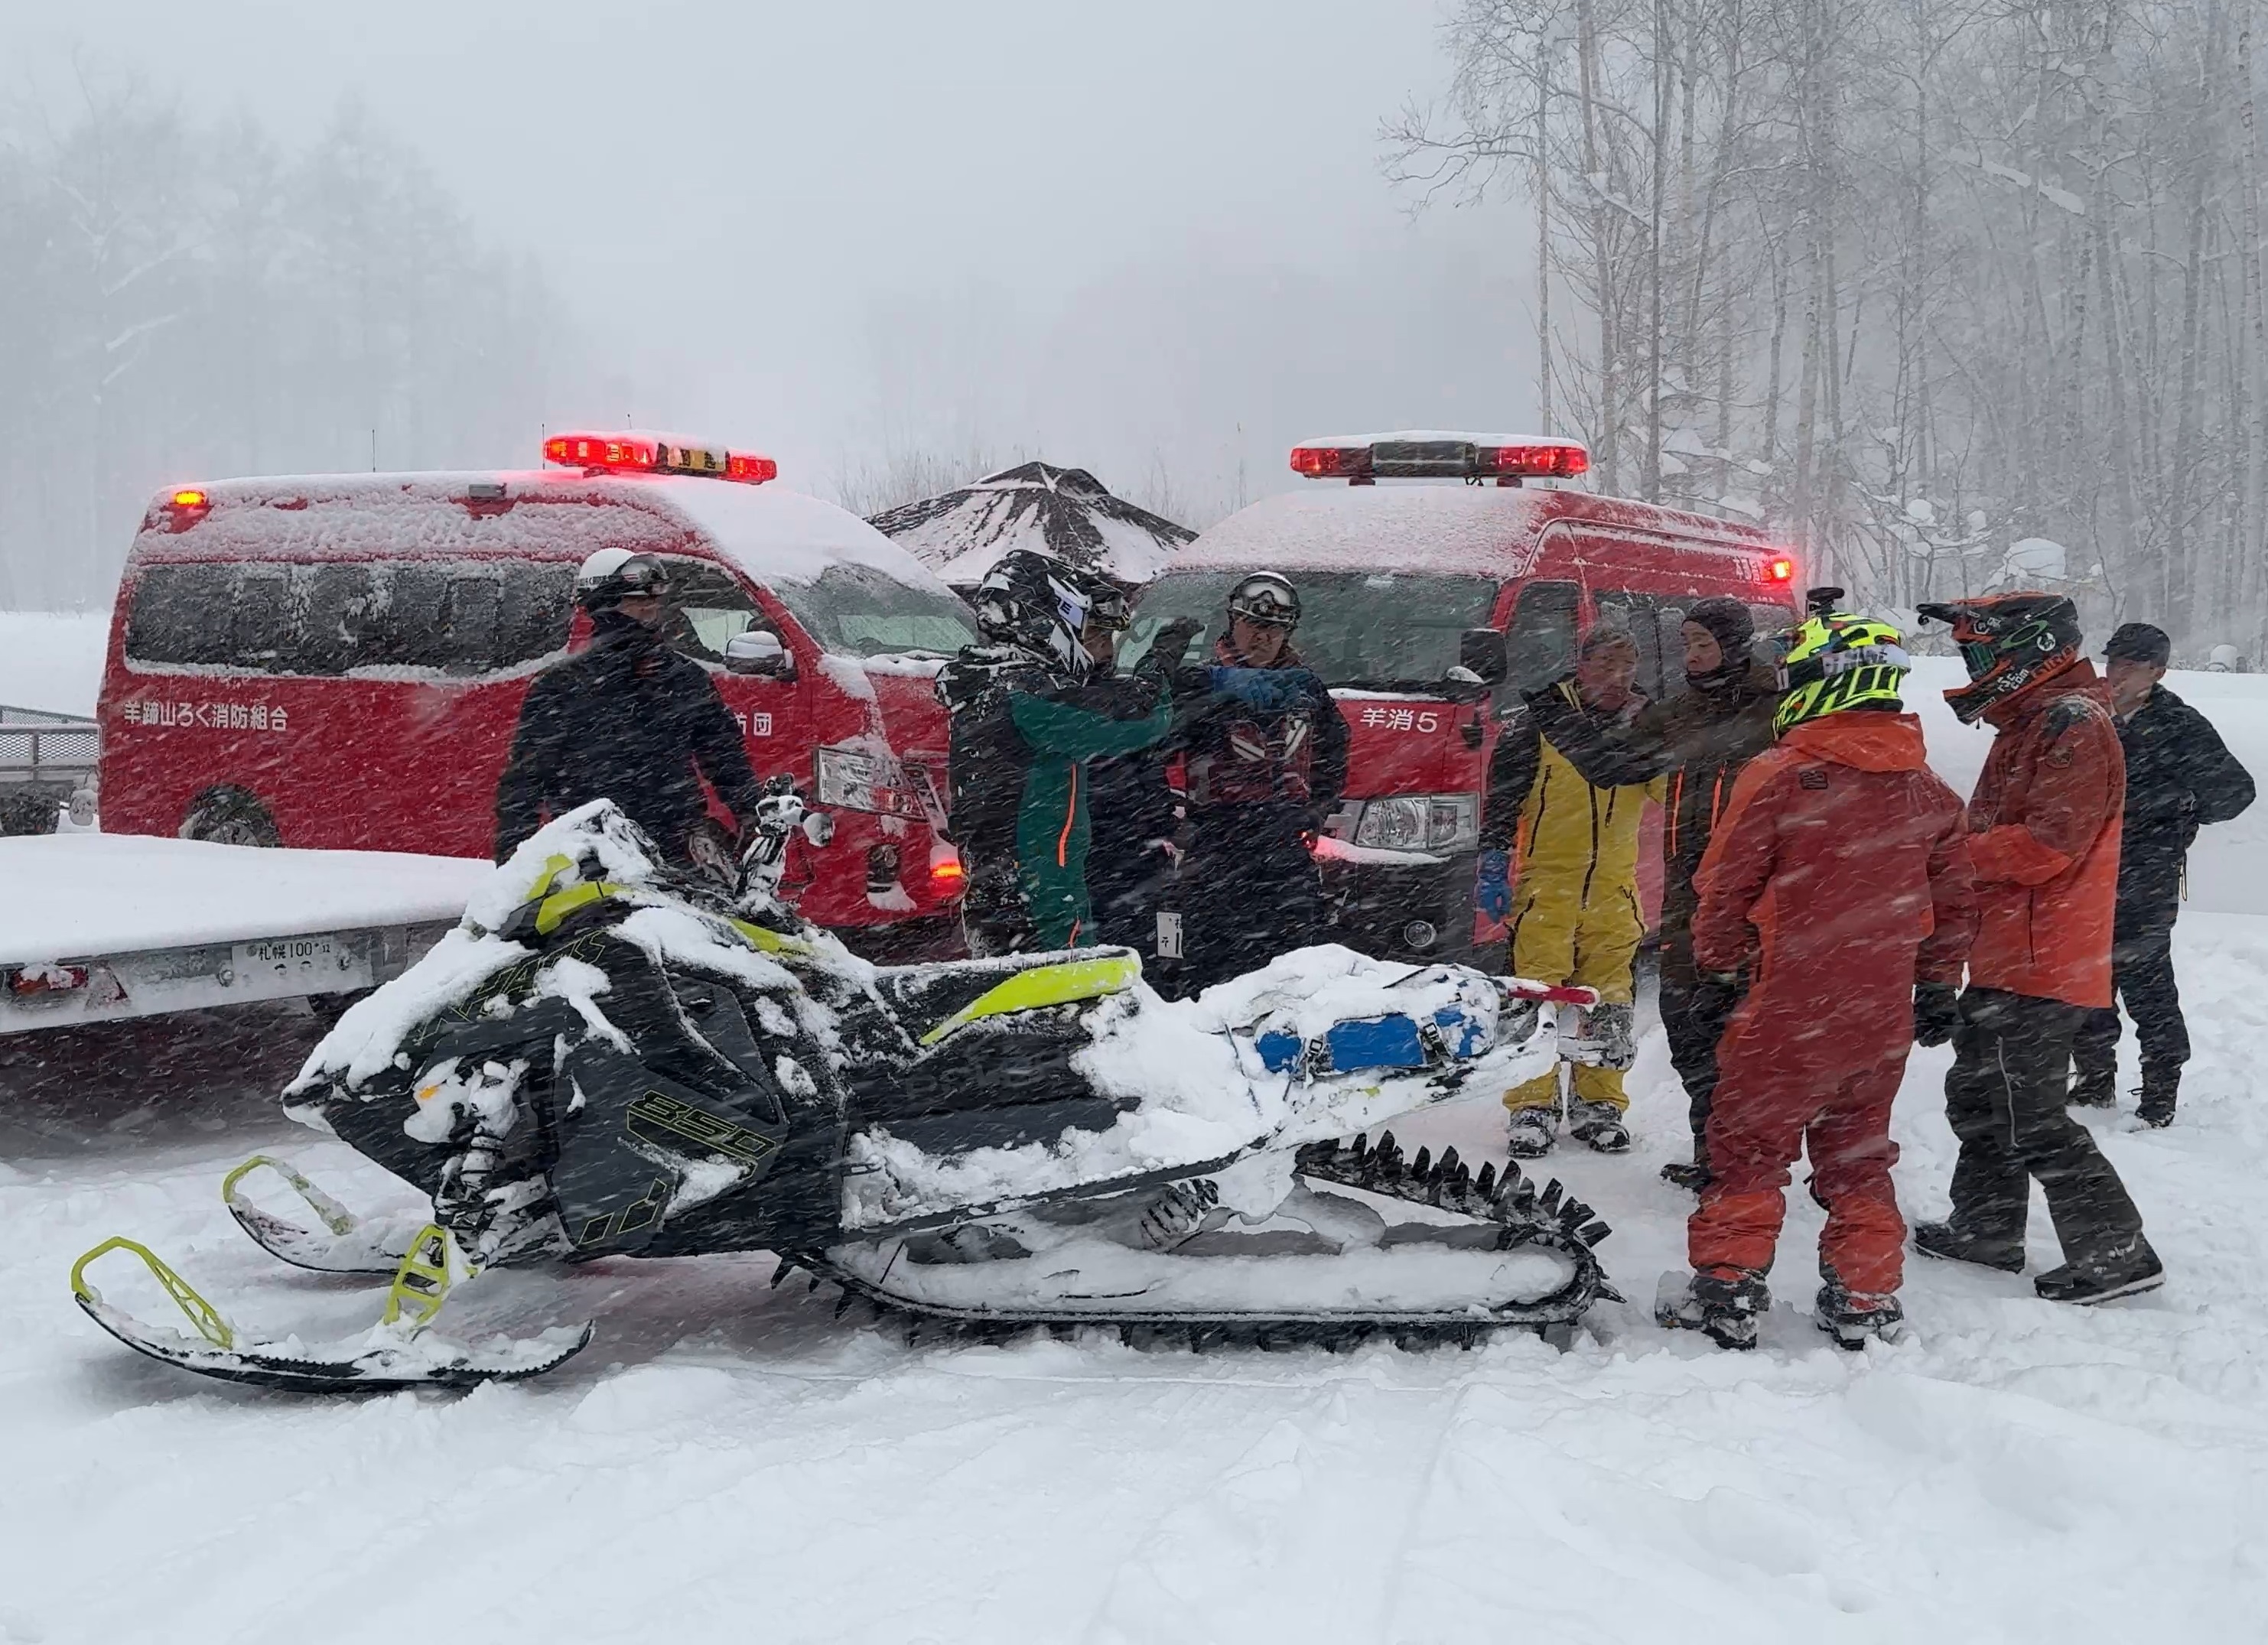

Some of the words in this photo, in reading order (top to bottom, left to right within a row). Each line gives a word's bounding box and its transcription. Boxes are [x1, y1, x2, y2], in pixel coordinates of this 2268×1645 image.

[124, 701, 288, 732] 羊蹄山ろく消防組合
[1360, 707, 1438, 733] 羊消5
[628, 1089, 777, 1160] 850
